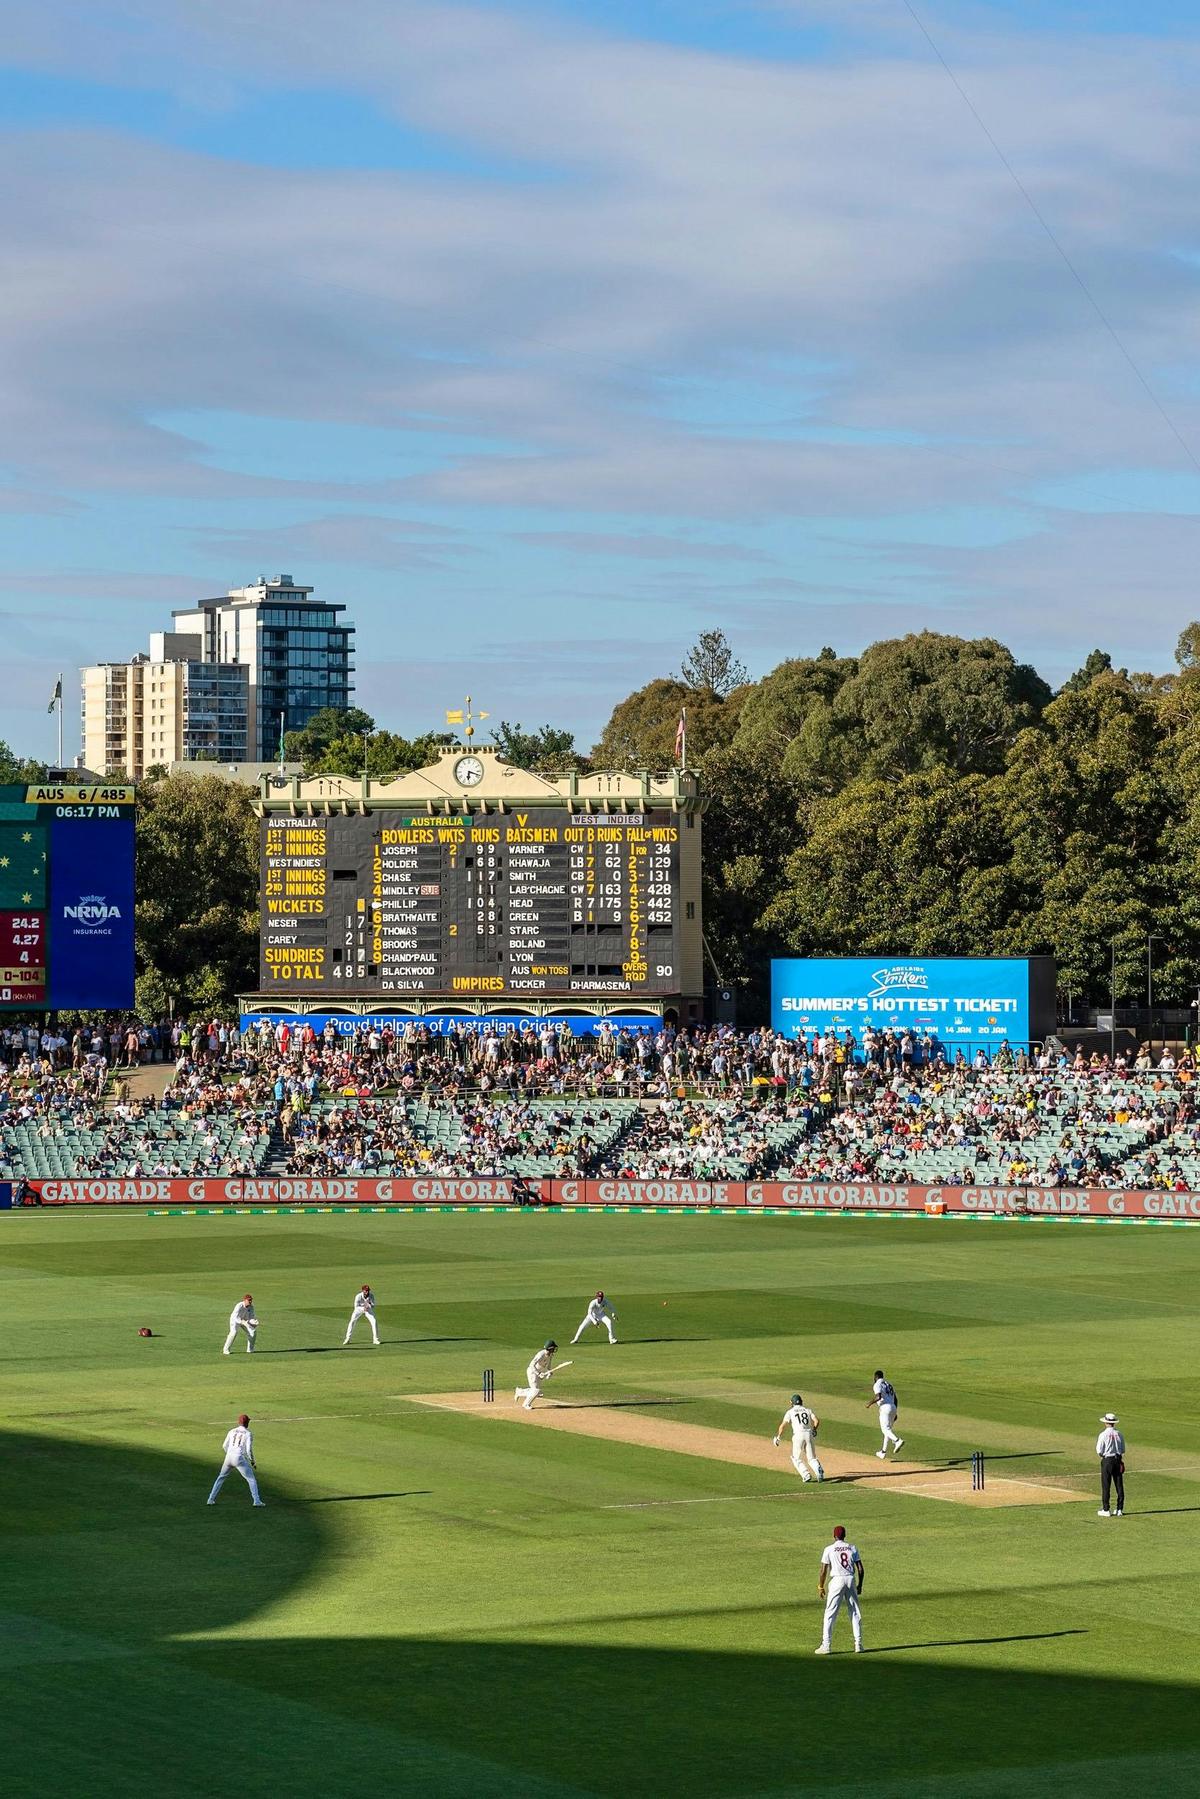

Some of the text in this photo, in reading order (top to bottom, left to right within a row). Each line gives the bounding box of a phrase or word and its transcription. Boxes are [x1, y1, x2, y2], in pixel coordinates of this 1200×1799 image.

[36, 789, 64, 799] AUS
[79, 789, 86, 800] 6
[101, 789, 126, 800] 485
[56, 806, 120, 818] 06:17 PM
[269, 819, 317, 827] AUSTRALIA
[410, 817, 463, 826] AUSTRALIA
[517, 815, 528, 827] V
[574, 816, 599, 824] WEST
[268, 830, 326, 842] 1ST INNINGS
[382, 829, 500, 843] BOWLERS WKTS RUNS
[506, 828, 622, 842] BATSMEN OUT B RUNS
[627, 828, 677, 841] FALL WKTS
[266, 843, 326, 855] 2ND INNINGS
[375, 844, 379, 856] 1
[382, 846, 417, 855] JOSEPH
[509, 845, 619, 854] WARNER CW 1 21
[630, 843, 671, 855] 1 FOR 34
[269, 859, 320, 867] WEST INDIES
[373, 858, 382, 870] 2
[382, 860, 418, 869] HOLDER
[509, 857, 621, 868] KHAWAJA LB 7 62
[628, 856, 671, 869] 2 129
[267, 869, 326, 881] 1ST INNINGS
[373, 871, 411, 883] 3 CHASE
[509, 871, 621, 881] SMITH CB 2 0
[629, 871, 668, 881] 3 131
[266, 883, 326, 895] 2ND INNINGS
[373, 884, 382, 896] 4
[382, 887, 420, 895] MINDLEY
[509, 885, 621, 895] LAB'CHAGNE CW 7 163
[629, 884, 671, 895] 4 428
[268, 900, 324, 913] WICKETS
[382, 901, 417, 909] PHILLIP
[509, 898, 621, 908] HEAD R 7 175
[630, 897, 671, 909] 5 442
[64, 906, 122, 918] NRMA
[373, 911, 437, 924] 6 BRATHWAITE
[509, 911, 621, 921] GREEN B 1 9
[630, 911, 671, 923] 6 452
[12, 918, 39, 929] 24.2
[268, 919, 297, 927] NESER
[373, 925, 382, 936] 7
[382, 927, 417, 935] THOMAS
[510, 926, 539, 935] STARC
[630, 925, 639, 936] 7
[13, 935, 39, 945] 4.27
[268, 936, 297, 944] CAREY
[373, 938, 417, 951] 8 BROOKS
[510, 939, 545, 948] BOLAND
[630, 938, 639, 950] 8
[20, 951, 29, 963] 4
[265, 949, 324, 962] SUNDRIES
[373, 952, 438, 963] 9 CHAND'PAUL
[510, 953, 533, 962] LYON
[630, 951, 640, 962] 9
[270, 965, 324, 979] TOTAL
[382, 967, 435, 975] BLACKWOOD
[511, 967, 568, 975] AUS WON TOSS
[622, 962, 647, 971] OVERS
[656, 965, 673, 976] 90
[382, 981, 424, 989] DA SILVA
[453, 977, 631, 990] UMPIRES TUCKER DHARMASENA
[782, 998, 1017, 1012] SUMMER'S HOTTEST TICKET!
[429, 1018, 444, 1032] of
[447, 1019, 515, 1032] Astralian
[519, 1019, 565, 1032] Cricke
[41, 1181, 171, 1201] GATORADE
[188, 1181, 205, 1200] G
[224, 1181, 358, 1200] GATORADE
[375, 1180, 393, 1200] G
[412, 1181, 542, 1201] GATORAE
[561, 1182, 578, 1201] G
[598, 1182, 729, 1203] GATORADE
[746, 1185, 762, 1204] G
[782, 1185, 909, 1207] GATORADE
[1108, 1193, 1125, 1213] G
[795, 1412, 809, 1426] 18
[840, 1552, 848, 1569] 8
